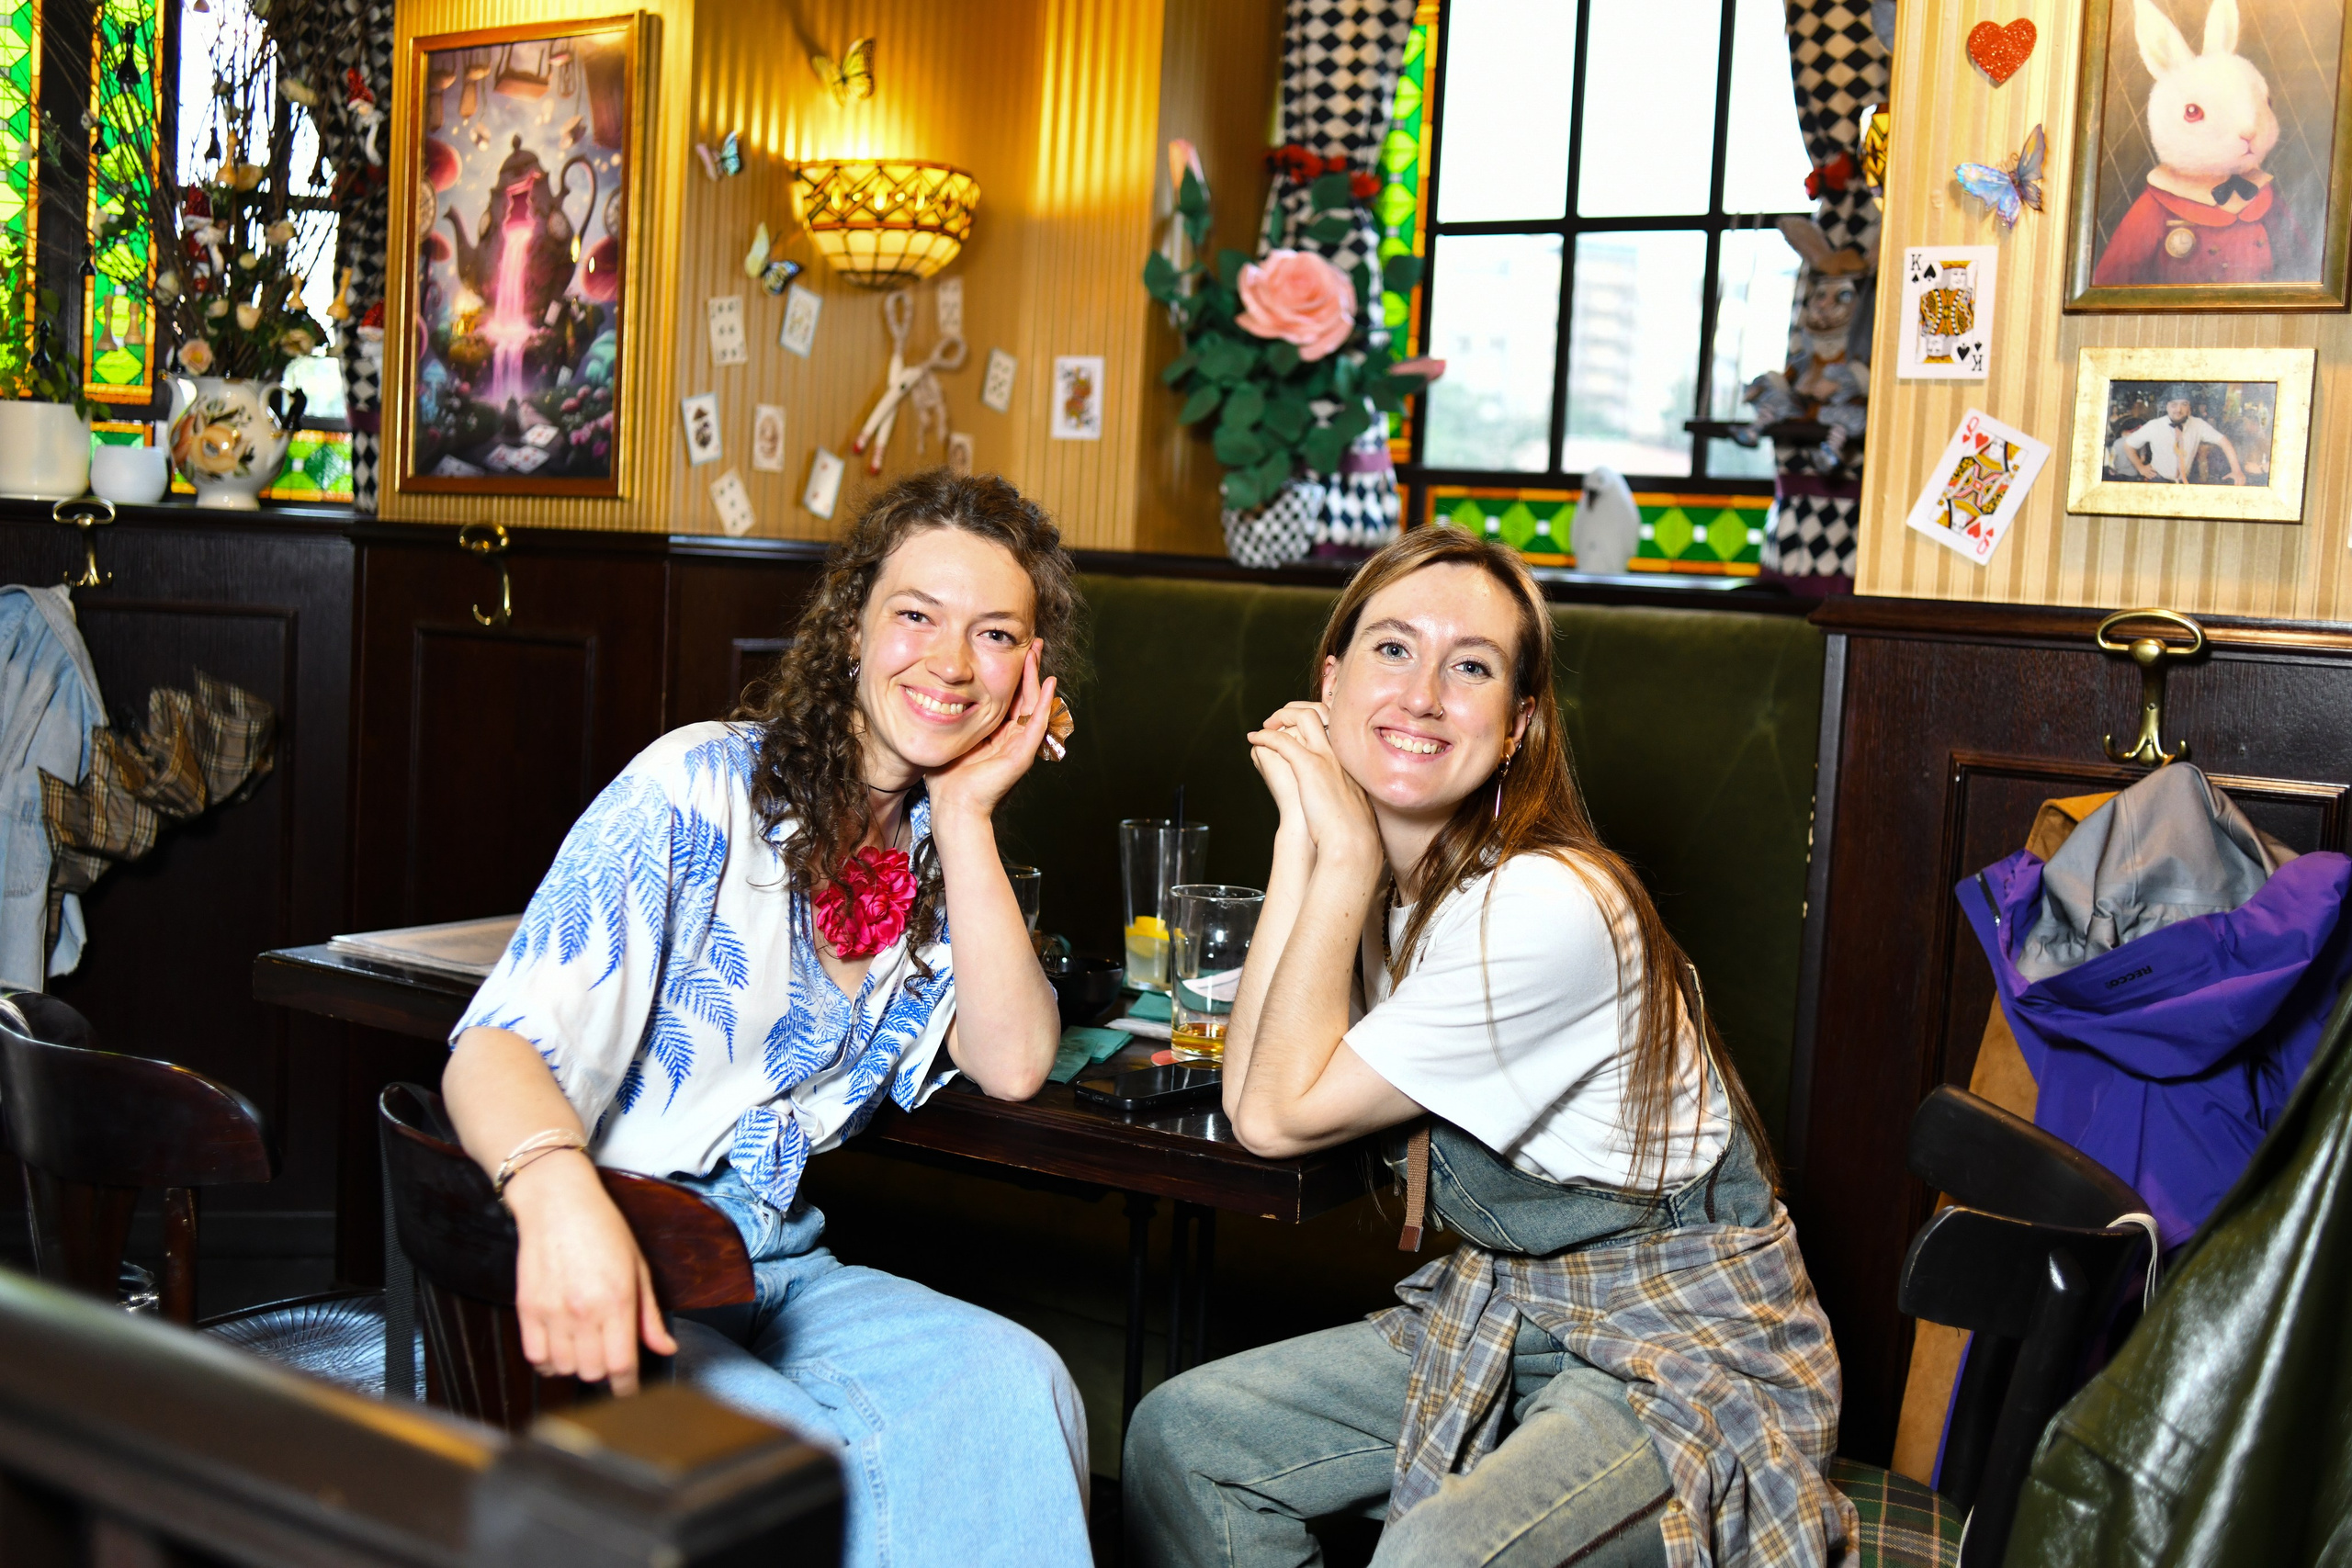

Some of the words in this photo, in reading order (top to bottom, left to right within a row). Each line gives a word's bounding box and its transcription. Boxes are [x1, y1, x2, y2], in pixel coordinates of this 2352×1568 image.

[1911, 254, 1922, 270] K
[1972, 355, 1983, 371] K
[1967, 416, 1980, 436] Q
[1976, 536, 1990, 555] Q
